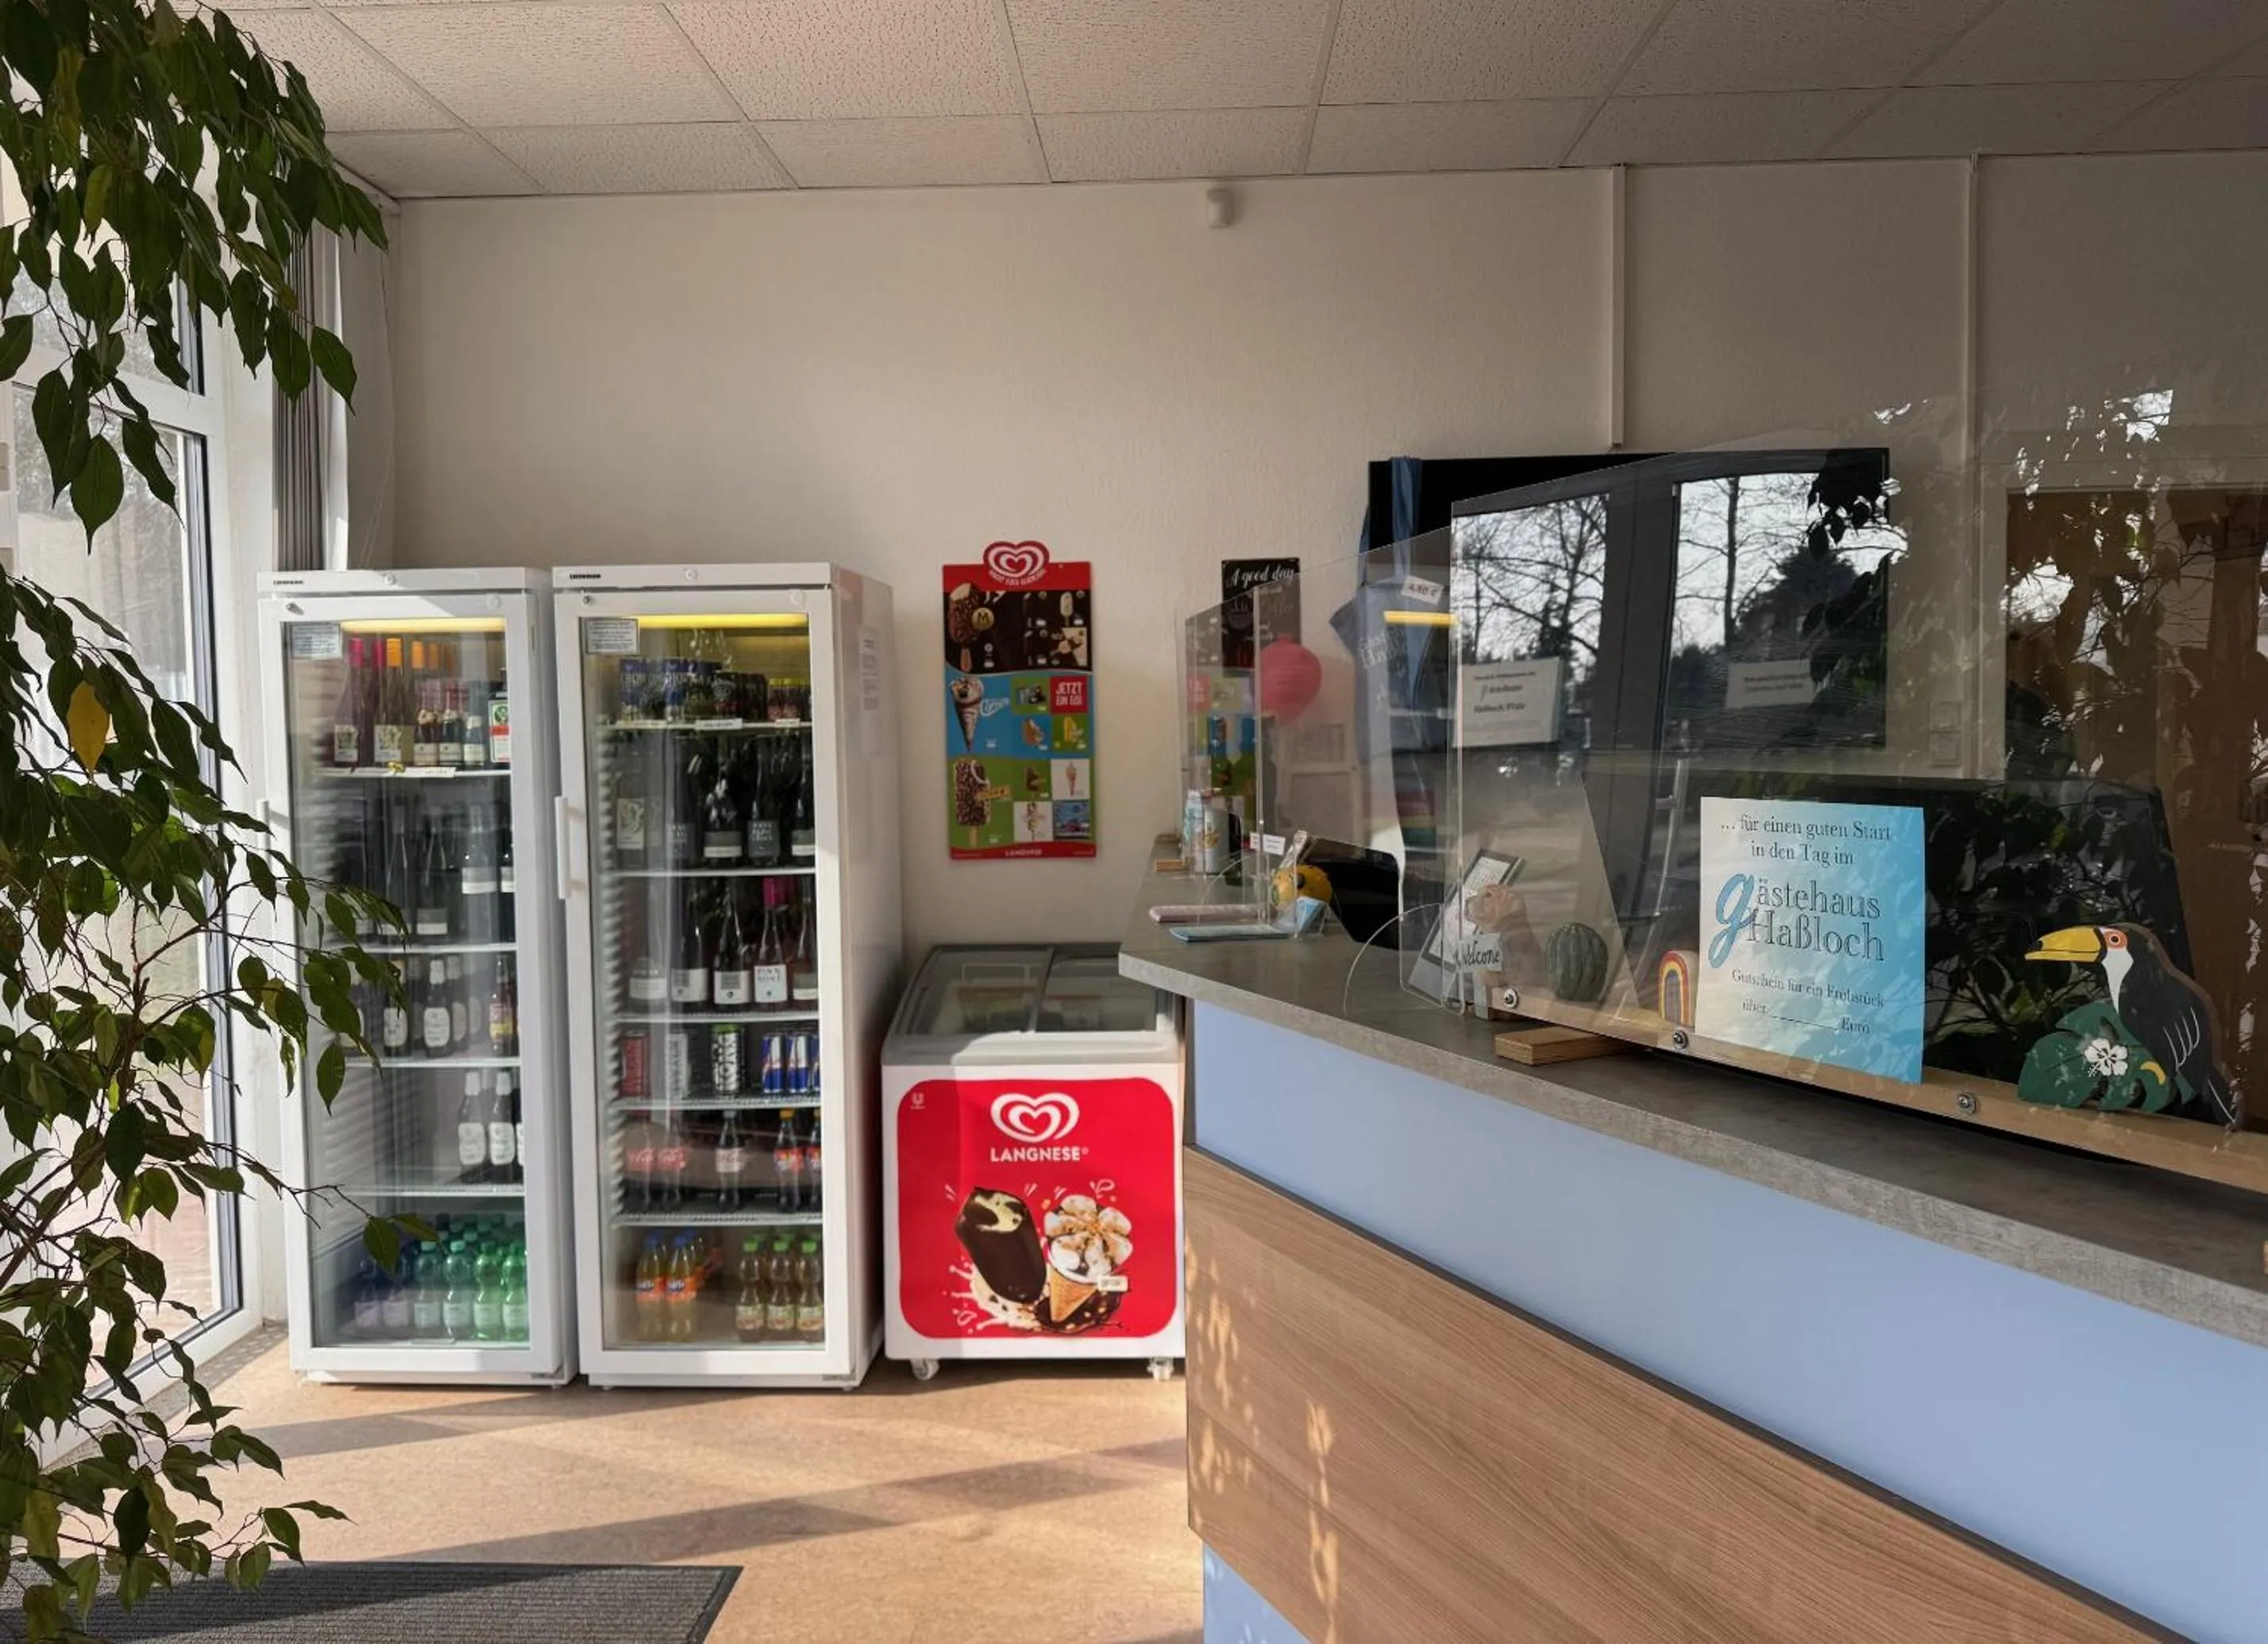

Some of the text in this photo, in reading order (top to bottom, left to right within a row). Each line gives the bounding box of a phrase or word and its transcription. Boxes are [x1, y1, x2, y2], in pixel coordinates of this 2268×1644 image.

[1242, 565, 1270, 589] good
[1272, 565, 1295, 586] day
[1055, 681, 1082, 695] JETZT
[1741, 814, 1759, 832] für
[1764, 816, 1802, 835] einen
[1807, 823, 1849, 840] guten
[1853, 820, 1891, 840] Start
[1751, 840, 1853, 868] in den Tag im
[1708, 873, 1881, 969] gästehaus
[1747, 907, 1884, 961] Haßloch
[1732, 969, 1784, 990] Gutschein
[1807, 983, 1822, 996] ein
[1840, 1017, 1870, 1033] Euro
[990, 1146, 1080, 1163] LANGNESE
